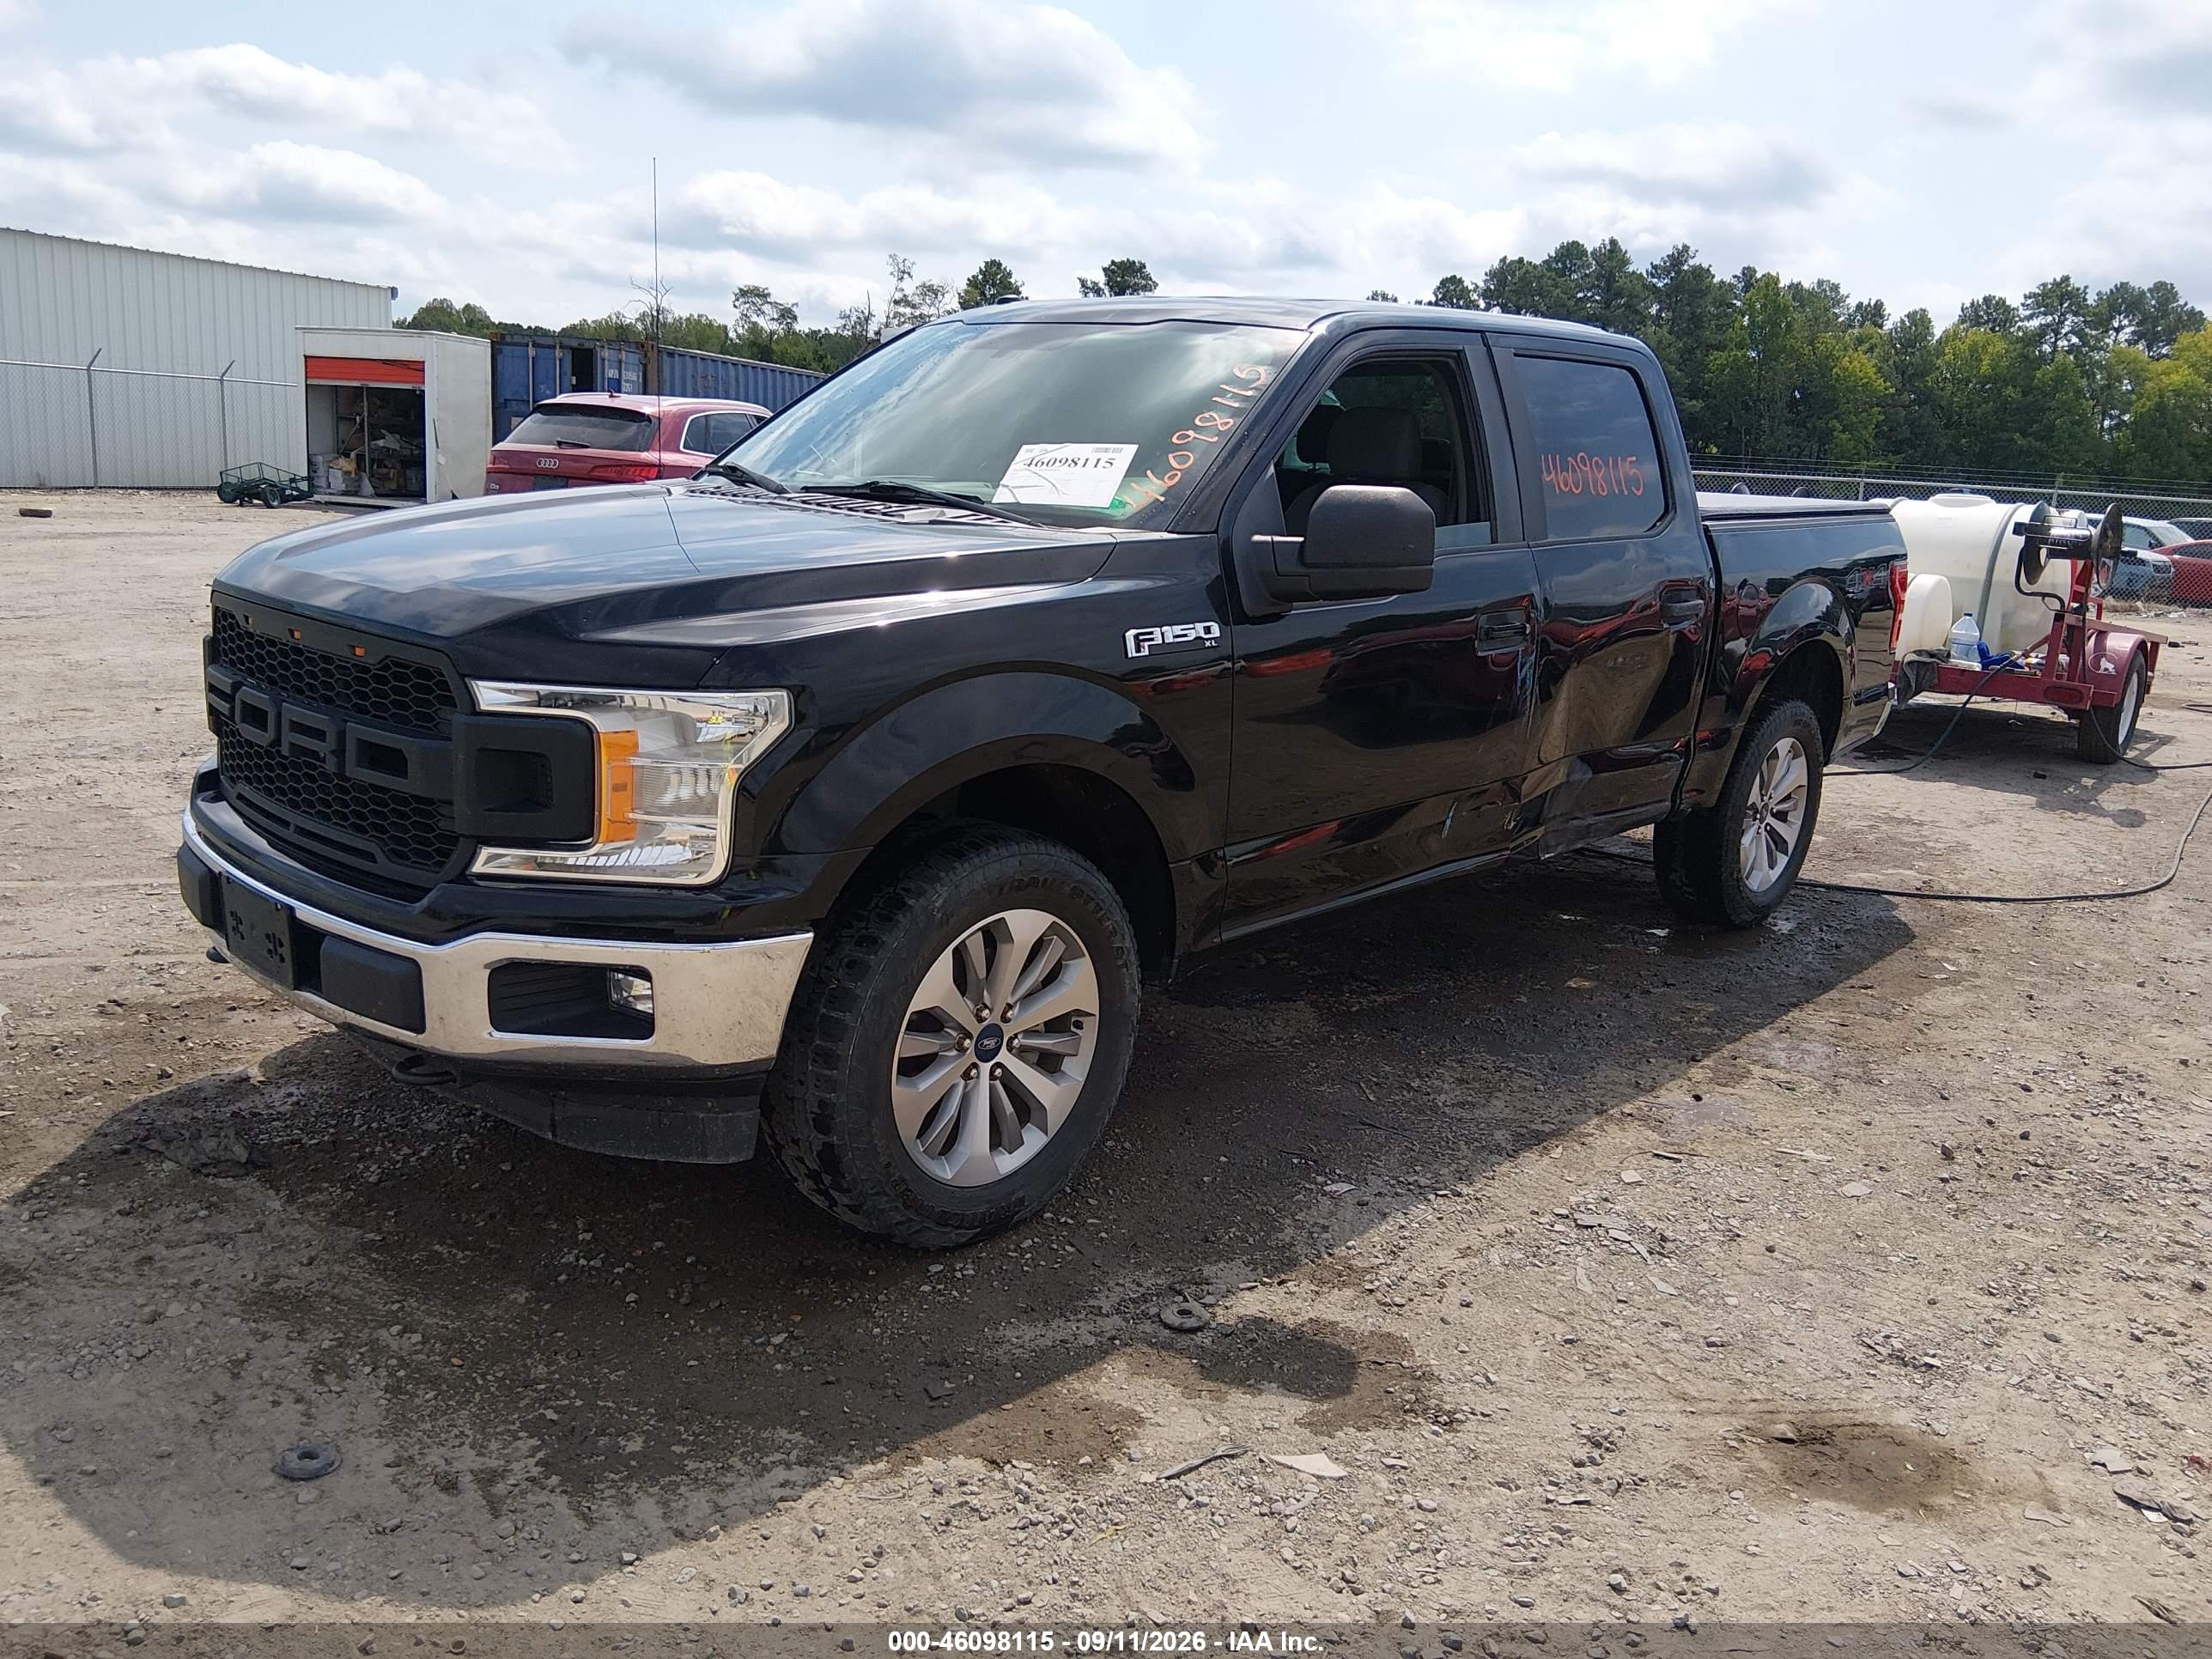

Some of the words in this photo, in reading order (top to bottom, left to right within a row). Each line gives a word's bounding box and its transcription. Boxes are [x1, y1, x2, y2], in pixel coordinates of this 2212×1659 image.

[1023, 457, 1116, 469] 46098115
[1123, 362, 1266, 508] 46098115
[1541, 452, 1644, 495] 46098115
[206, 664, 414, 787] FORD
